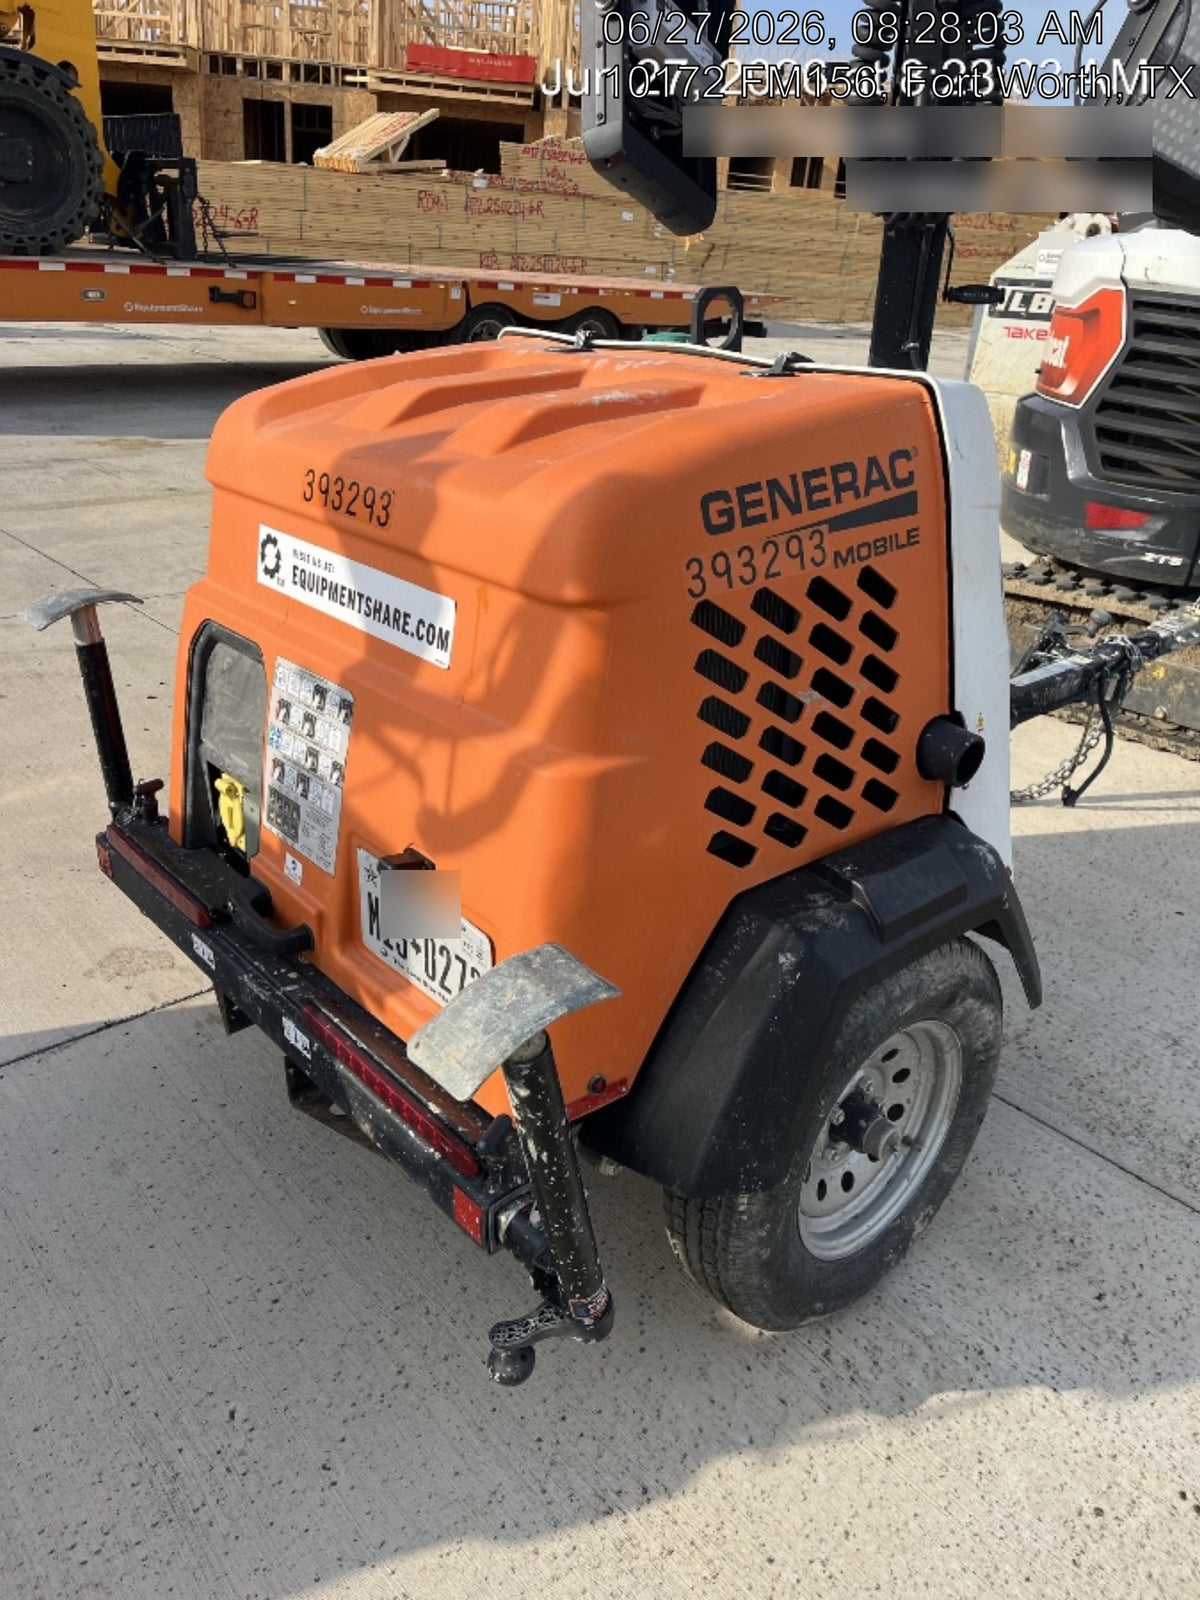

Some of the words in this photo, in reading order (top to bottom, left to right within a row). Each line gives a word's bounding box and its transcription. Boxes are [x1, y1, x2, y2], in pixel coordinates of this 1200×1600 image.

[1003, 326, 1050, 341] Take
[303, 468, 391, 527] 393293
[701, 448, 915, 535] GENERAC
[685, 528, 827, 598] 393293
[833, 526, 921, 569] MOBILE
[292, 564, 450, 653] EQUIPMENTSHARE.COM
